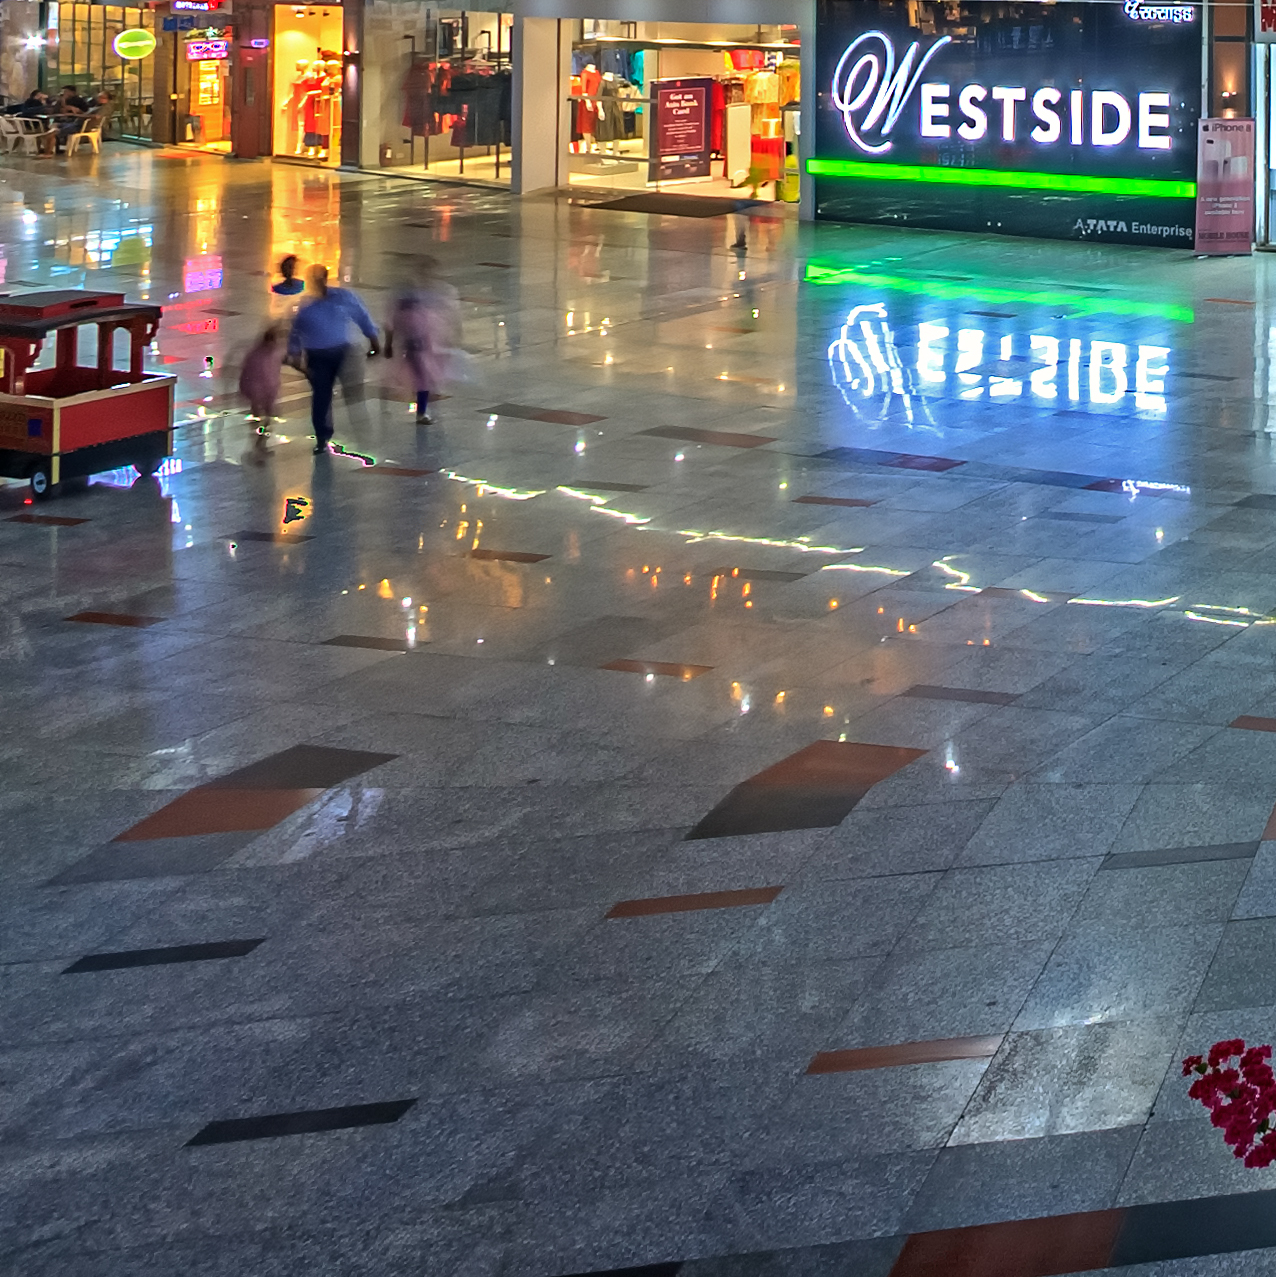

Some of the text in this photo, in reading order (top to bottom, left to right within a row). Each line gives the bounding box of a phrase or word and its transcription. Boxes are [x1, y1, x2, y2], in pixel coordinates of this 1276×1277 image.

[830, 29, 1173, 154] WESTSIDE
[1211, 122, 1244, 133] iPhone
[1086, 219, 1128, 234] TATA
[1131, 221, 1193, 238] Enterprise
